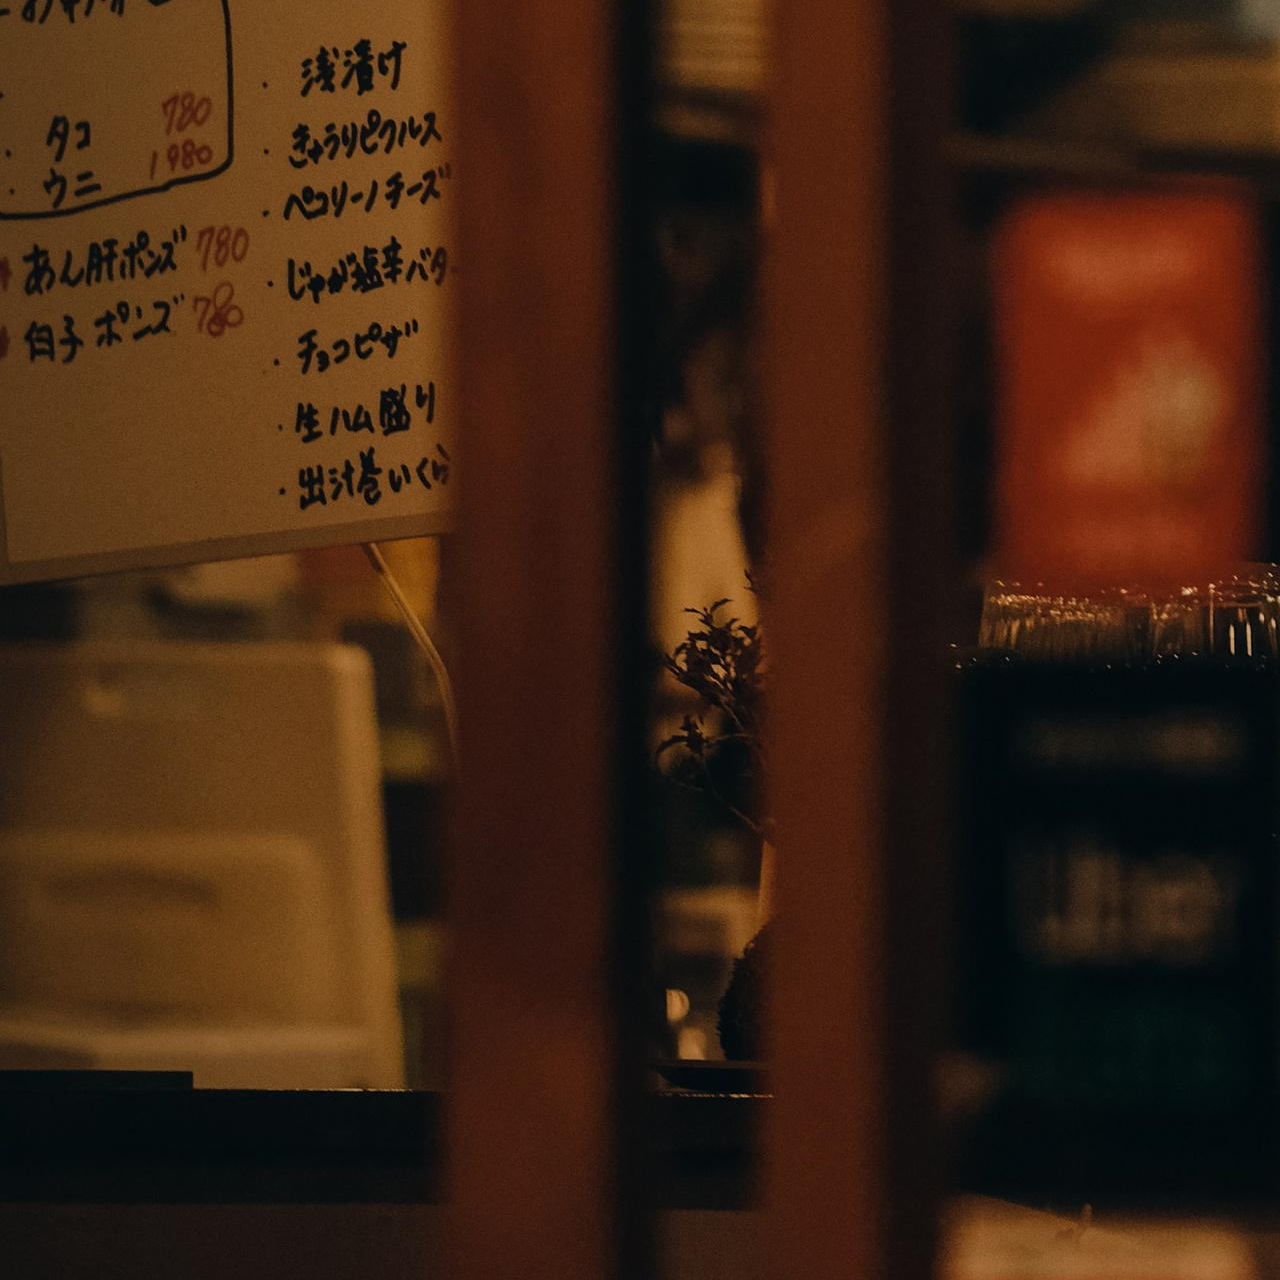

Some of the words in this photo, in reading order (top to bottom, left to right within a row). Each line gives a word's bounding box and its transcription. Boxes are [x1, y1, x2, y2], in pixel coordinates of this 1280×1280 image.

[301, 38, 407, 97] 浅漬け
[46, 115, 91, 162] タコ
[161, 91, 212, 135] 780
[43, 168, 102, 208] ウニ
[150, 138, 213, 180] 1980
[197, 225, 250, 272] 780
[298, 318, 418, 375] チョコピザ
